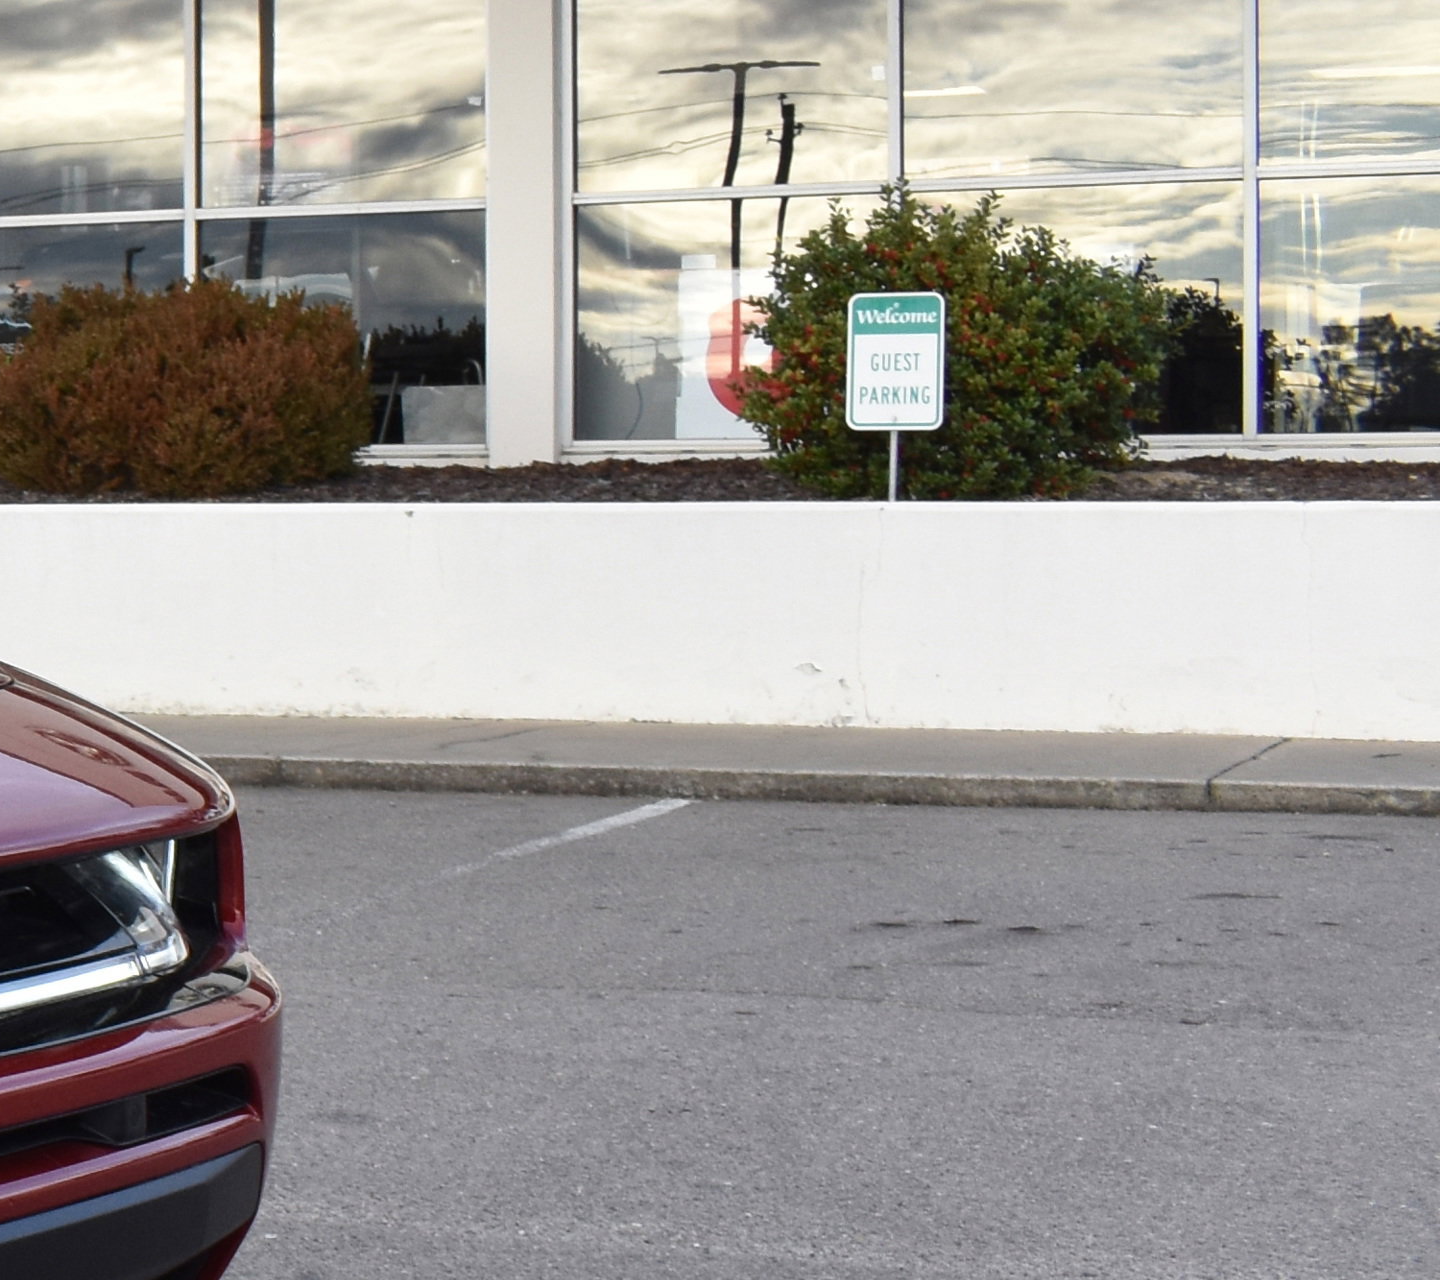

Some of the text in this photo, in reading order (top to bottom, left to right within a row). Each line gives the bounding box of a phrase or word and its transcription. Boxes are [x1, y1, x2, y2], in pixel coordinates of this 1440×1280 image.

[857, 305, 937, 324] Welcome
[870, 353, 921, 372] GUEST
[859, 386, 931, 404] PARKING
